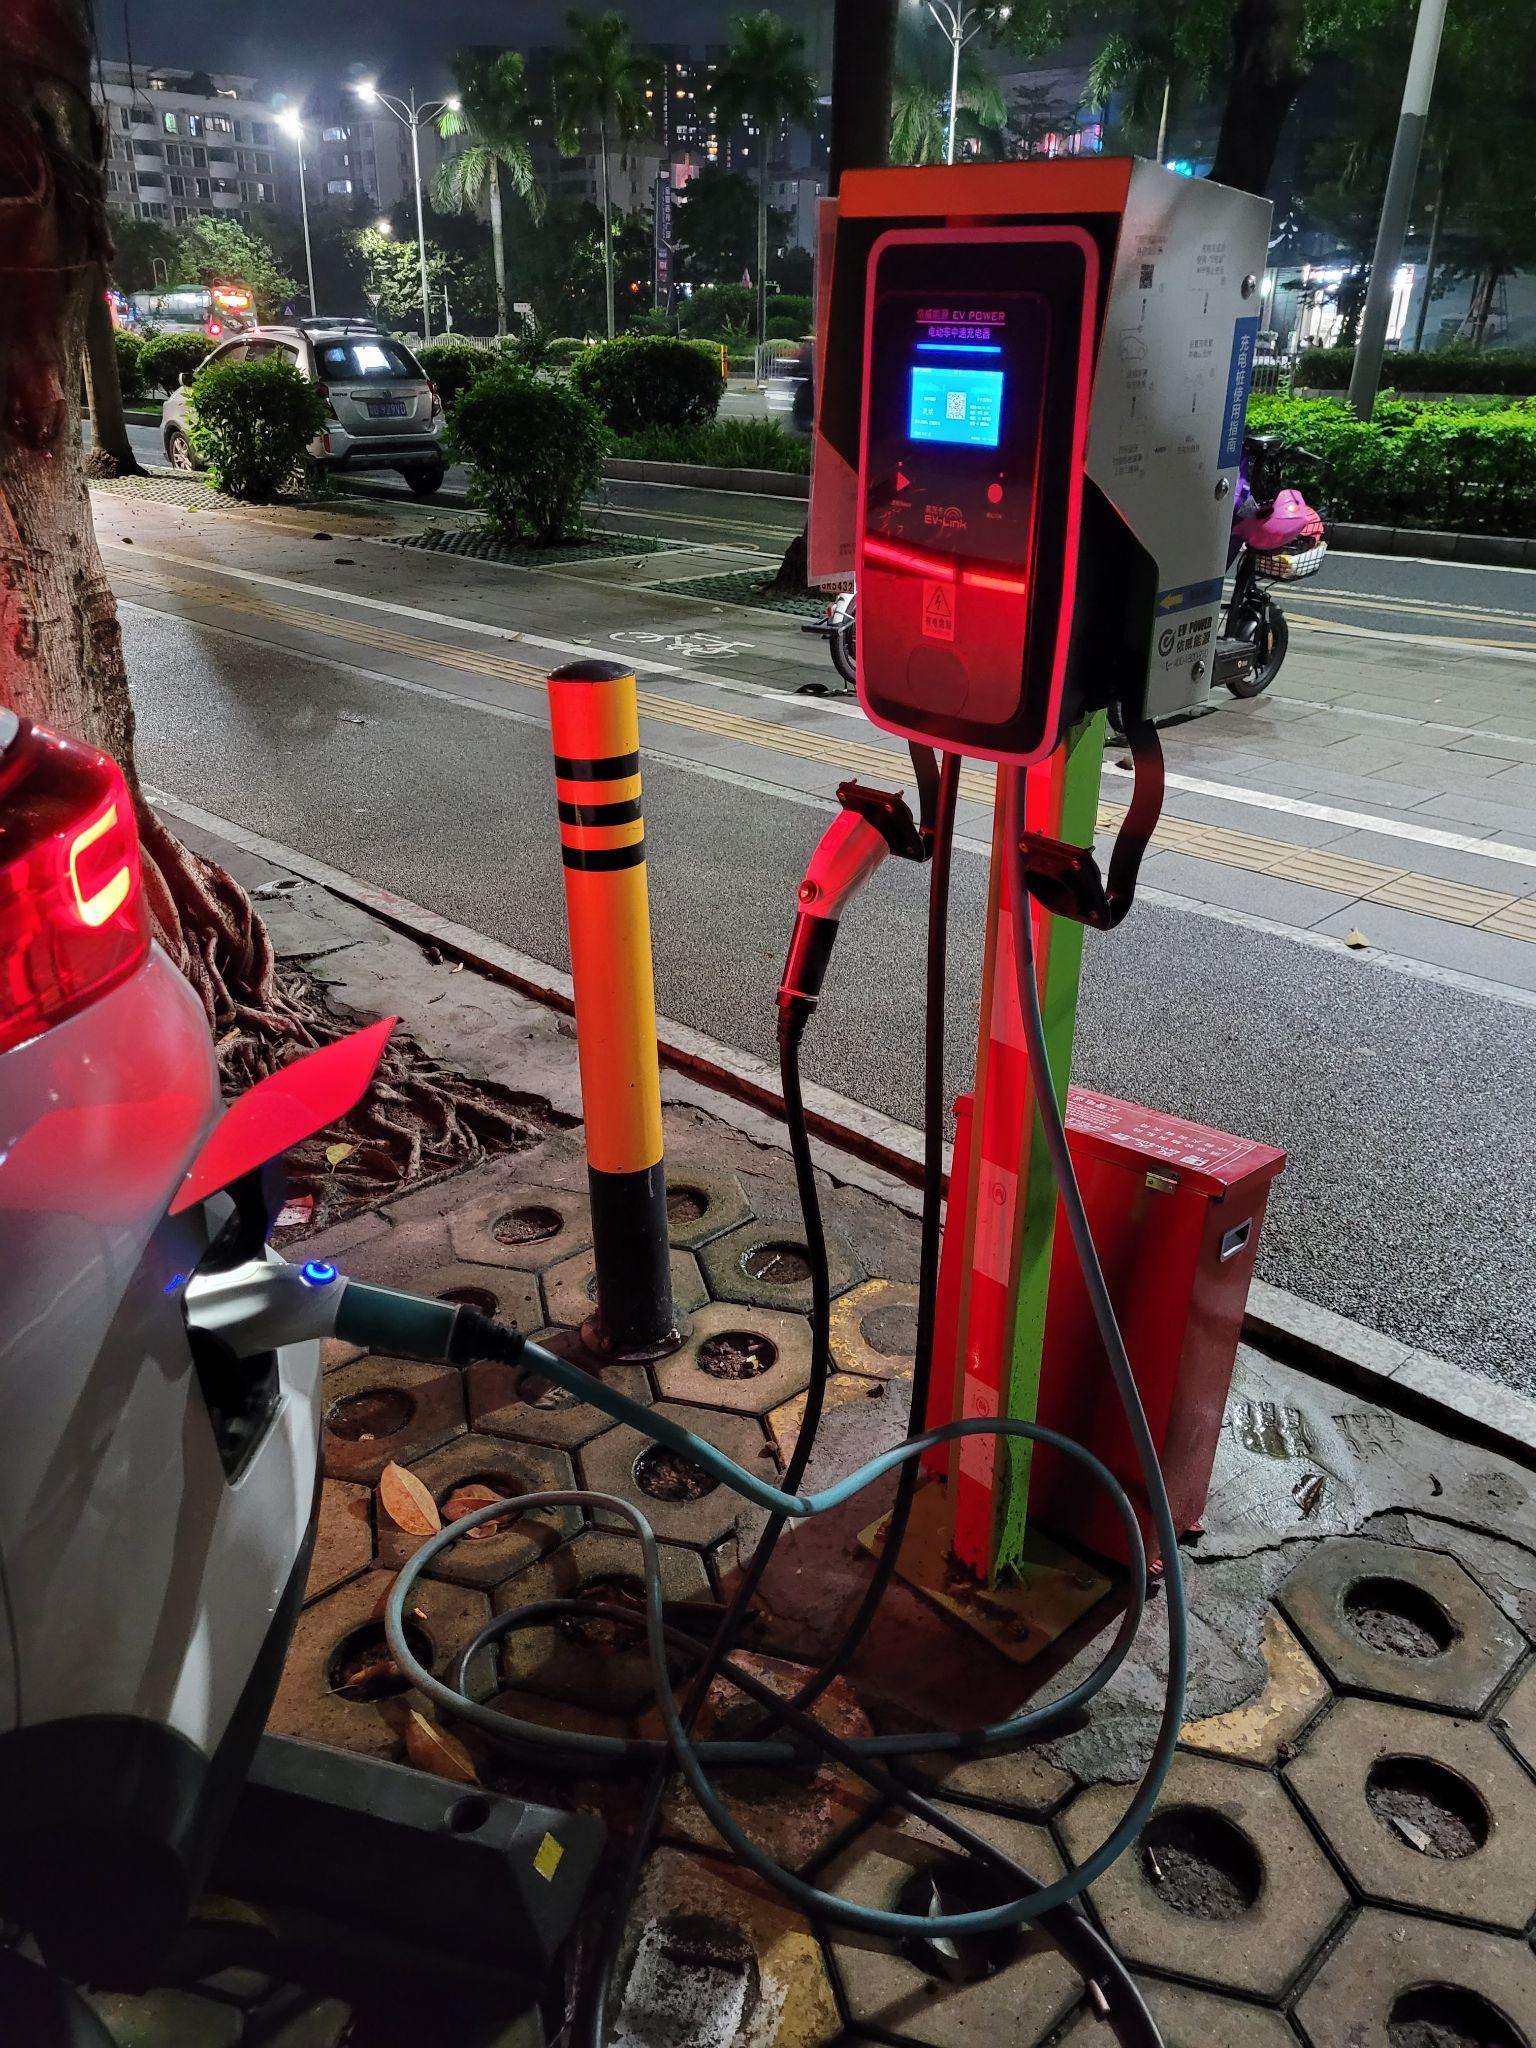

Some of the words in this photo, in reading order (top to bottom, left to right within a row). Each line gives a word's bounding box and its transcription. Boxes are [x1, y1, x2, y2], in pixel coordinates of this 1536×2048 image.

[952, 311, 966, 320] EV
[968, 311, 1006, 322] POWER
[928, 327, 991, 340] 电动车中速充电器
[1226, 334, 1251, 453] 充电桩使用指南
[1178, 624, 1187, 637] EV
[1189, 617, 1212, 634] POWER
[1176, 631, 1211, 653] 依威能源
